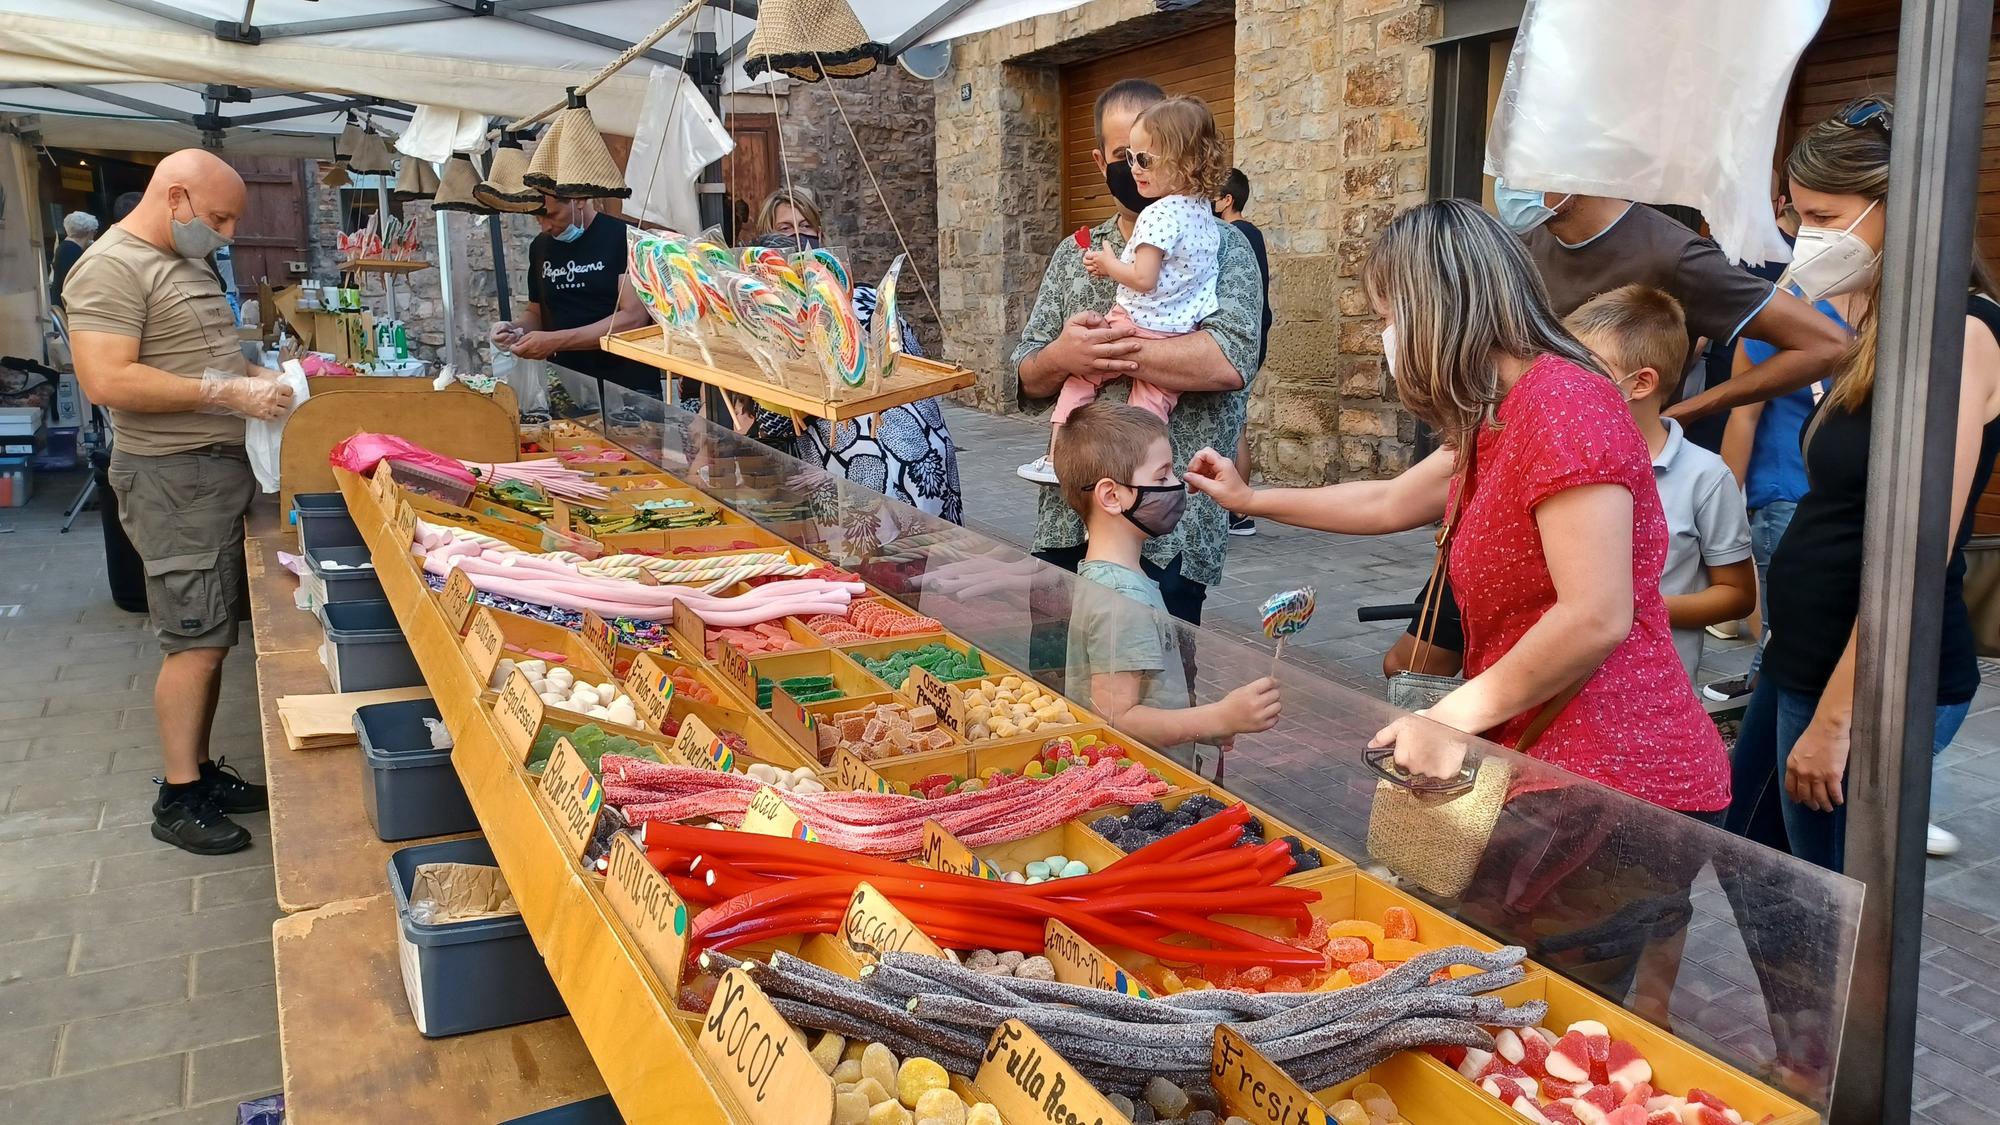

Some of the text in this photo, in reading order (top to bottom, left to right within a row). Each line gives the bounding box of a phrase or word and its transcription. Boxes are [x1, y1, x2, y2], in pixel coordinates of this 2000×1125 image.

[542, 260, 605, 283] Pepe Jeans
[627, 659, 664, 720] Frutos rojos
[923, 673, 952, 709] Ossets
[611, 838, 674, 933] nougat
[708, 972, 788, 1102] Xocot
[986, 1022, 1046, 1101] Fulla
[1215, 1034, 1310, 1125] Fresit
